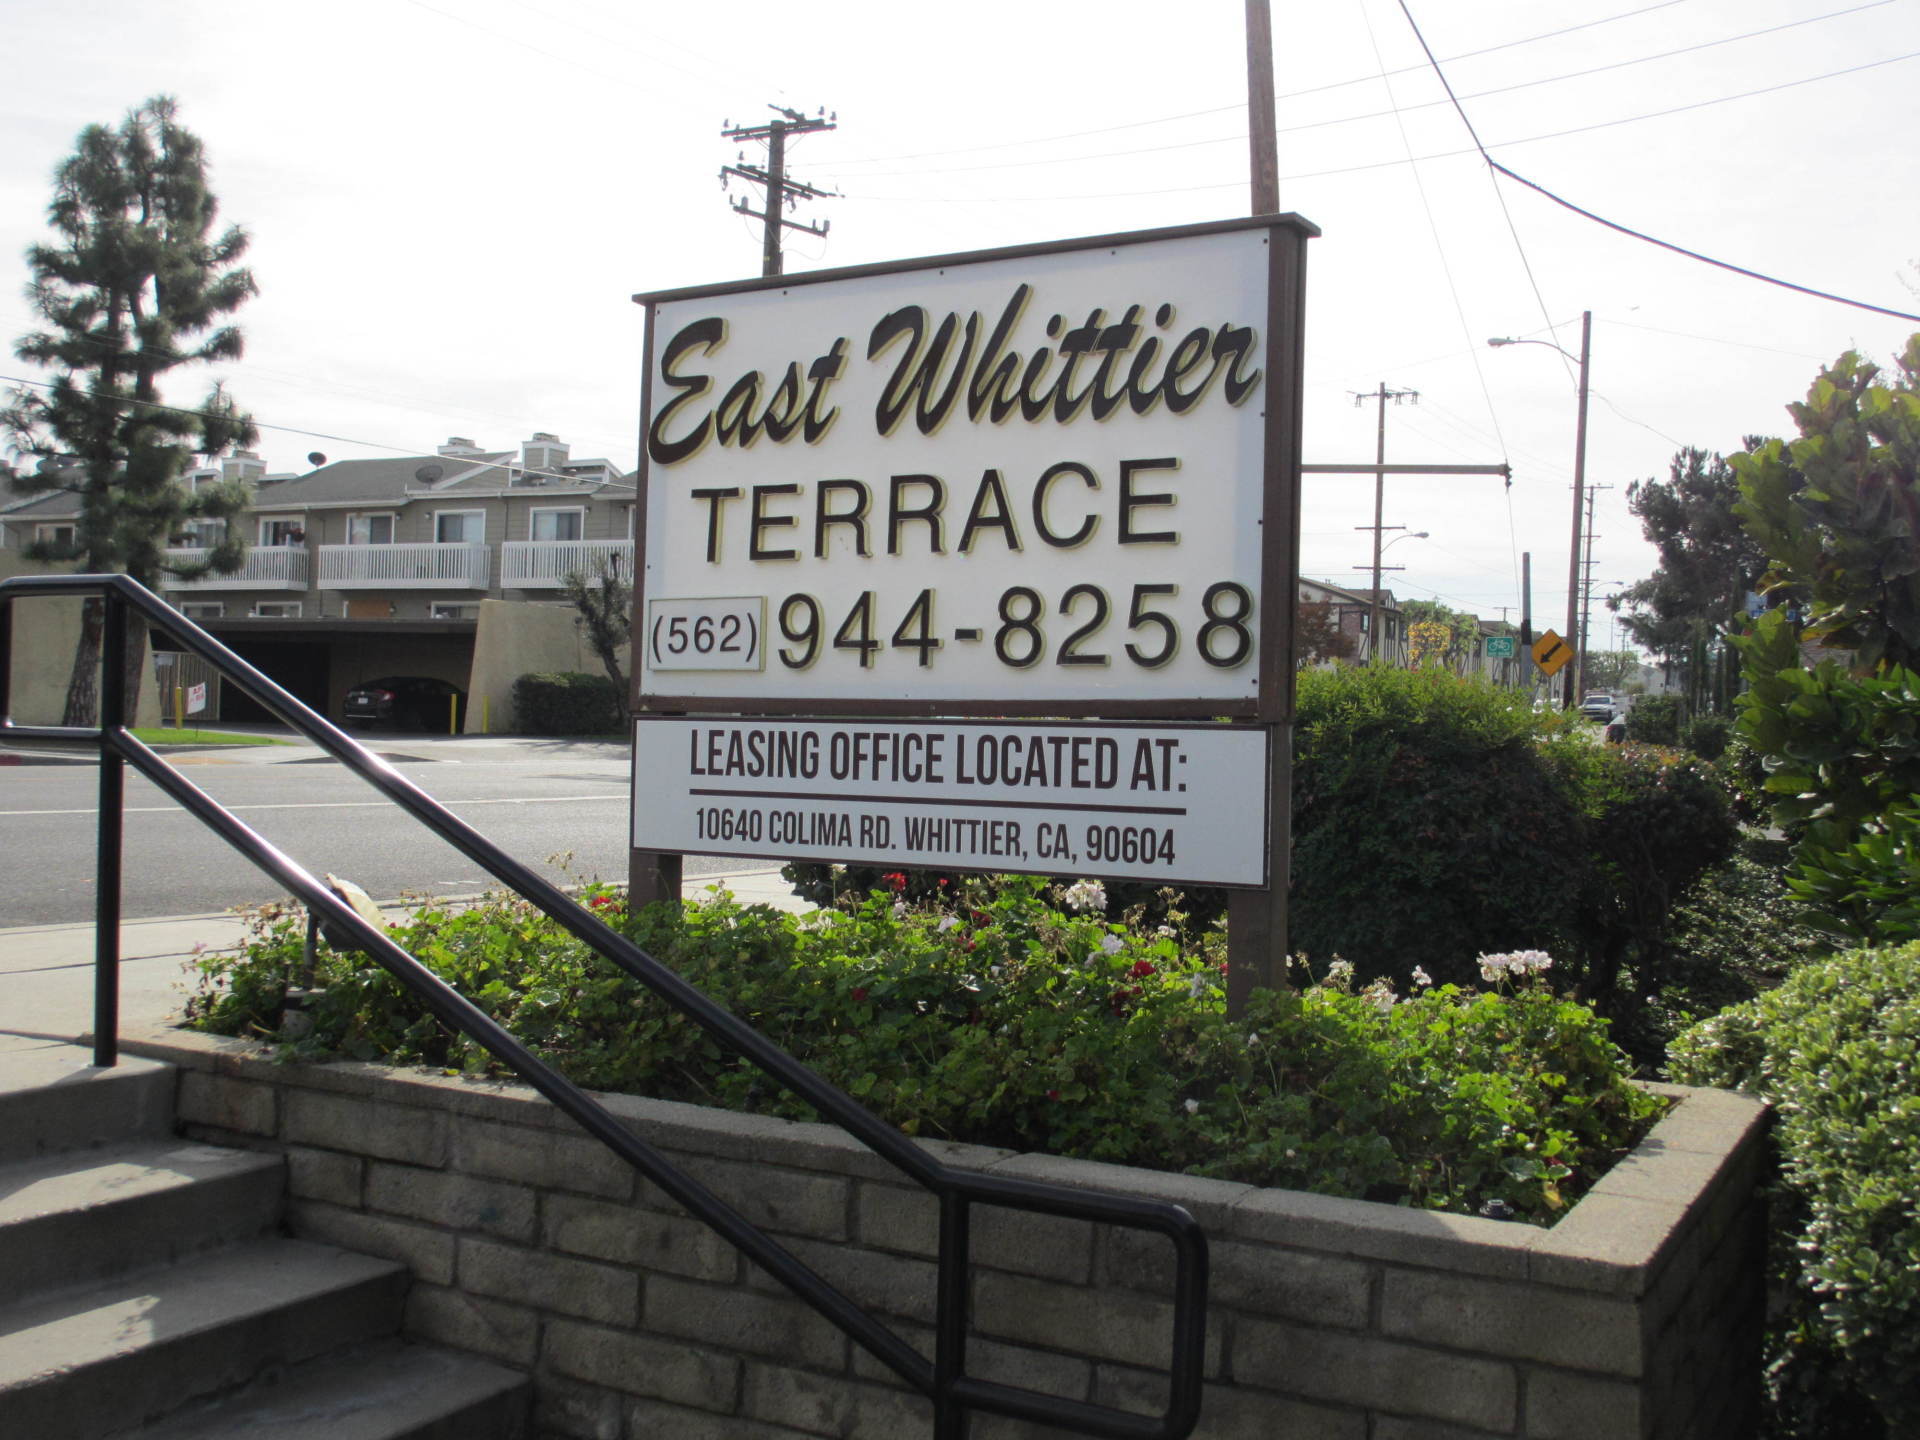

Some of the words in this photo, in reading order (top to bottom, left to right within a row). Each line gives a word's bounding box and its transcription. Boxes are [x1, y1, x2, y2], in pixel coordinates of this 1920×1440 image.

[648, 317, 850, 464] East
[867, 283, 1261, 436] Whittier
[691, 457, 1181, 562] TERRACE
[651, 613, 758, 661] (562)
[777, 581, 1255, 669] 944-8258
[690, 729, 820, 778] LEASING
[829, 732, 944, 784] OFFICE
[956, 734, 1117, 788] LOCATED
[1130, 738, 1187, 792] AT:
[696, 807, 763, 842] 10640
[769, 811, 851, 847] COLIMA
[860, 815, 896, 850] RD.
[904, 816, 1028, 861] WHITTIER,
[1036, 823, 1077, 864] CA,
[1085, 825, 1176, 865] 90604
